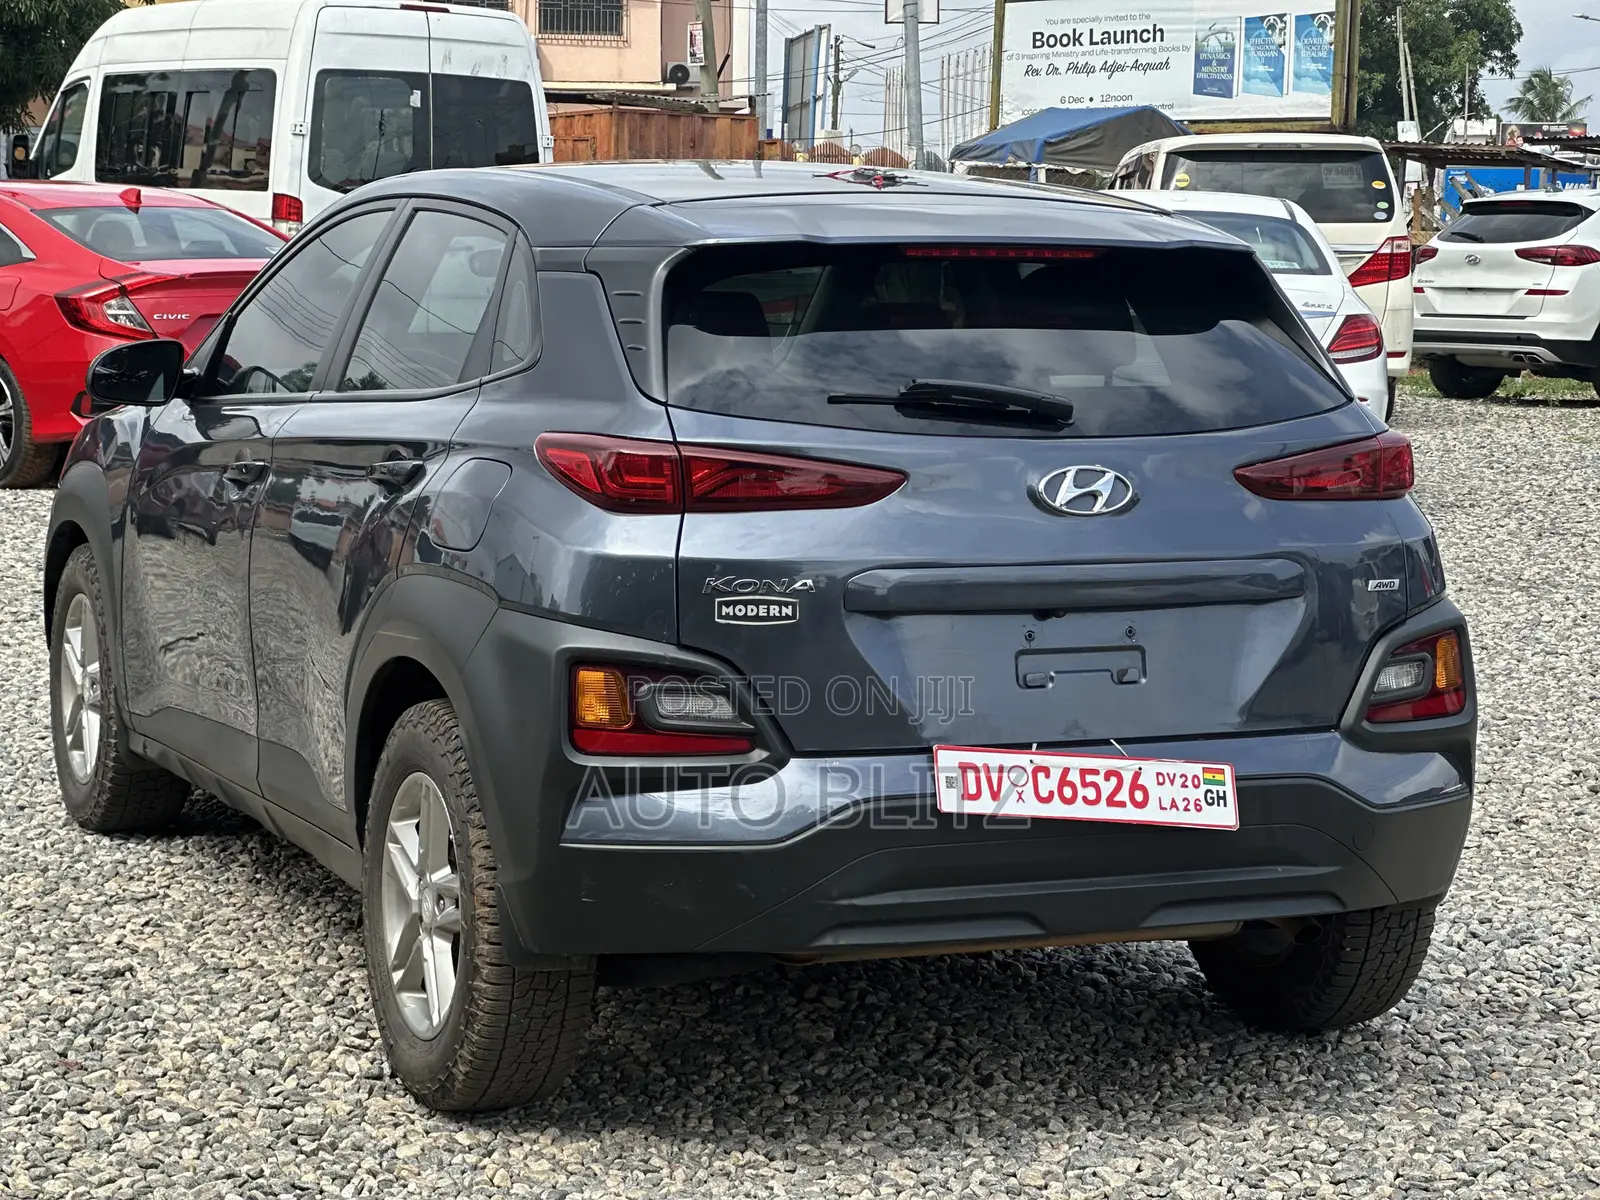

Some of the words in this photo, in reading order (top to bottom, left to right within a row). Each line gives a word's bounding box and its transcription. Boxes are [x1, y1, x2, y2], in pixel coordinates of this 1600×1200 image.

[1045, 18, 1059, 26] You
[1060, 17, 1072, 25] are
[1072, 15, 1103, 25] specially
[1104, 14, 1129, 23] invited
[1129, 13, 1138, 22] to
[1138, 12, 1151, 21] the
[1032, 28, 1084, 50] Book
[1089, 23, 1165, 46] Launch
[1006, 53, 1015, 61] of
[1015, 53, 1021, 61] 3
[1021, 51, 1051, 61] Inspiring
[1051, 50, 1080, 60] Ministry
[1080, 49, 1095, 57] and
[1095, 46, 1158, 56] Life-transforming
[1158, 45, 1181, 53] Books
[1181, 44, 1192, 53] by
[1199, 52, 1231, 60] DYNAMICS
[1024, 64, 1042, 77] Rev.
[1045, 63, 1062, 76] Dr.
[1065, 61, 1097, 78] Philip
[1099, 56, 1171, 81] Adjei-Acquah
[1060, 96, 1066, 104] 6
[1067, 95, 1085, 104] Dec
[1100, 94, 1133, 103] 12noon
[702, 575, 817, 594] KONA
[1373, 580, 1395, 589] AWD
[721, 604, 793, 618] MODERN
[957, 761, 1004, 802] DV
[1031, 764, 1150, 810] C6526
[1204, 788, 1228, 808] GH
